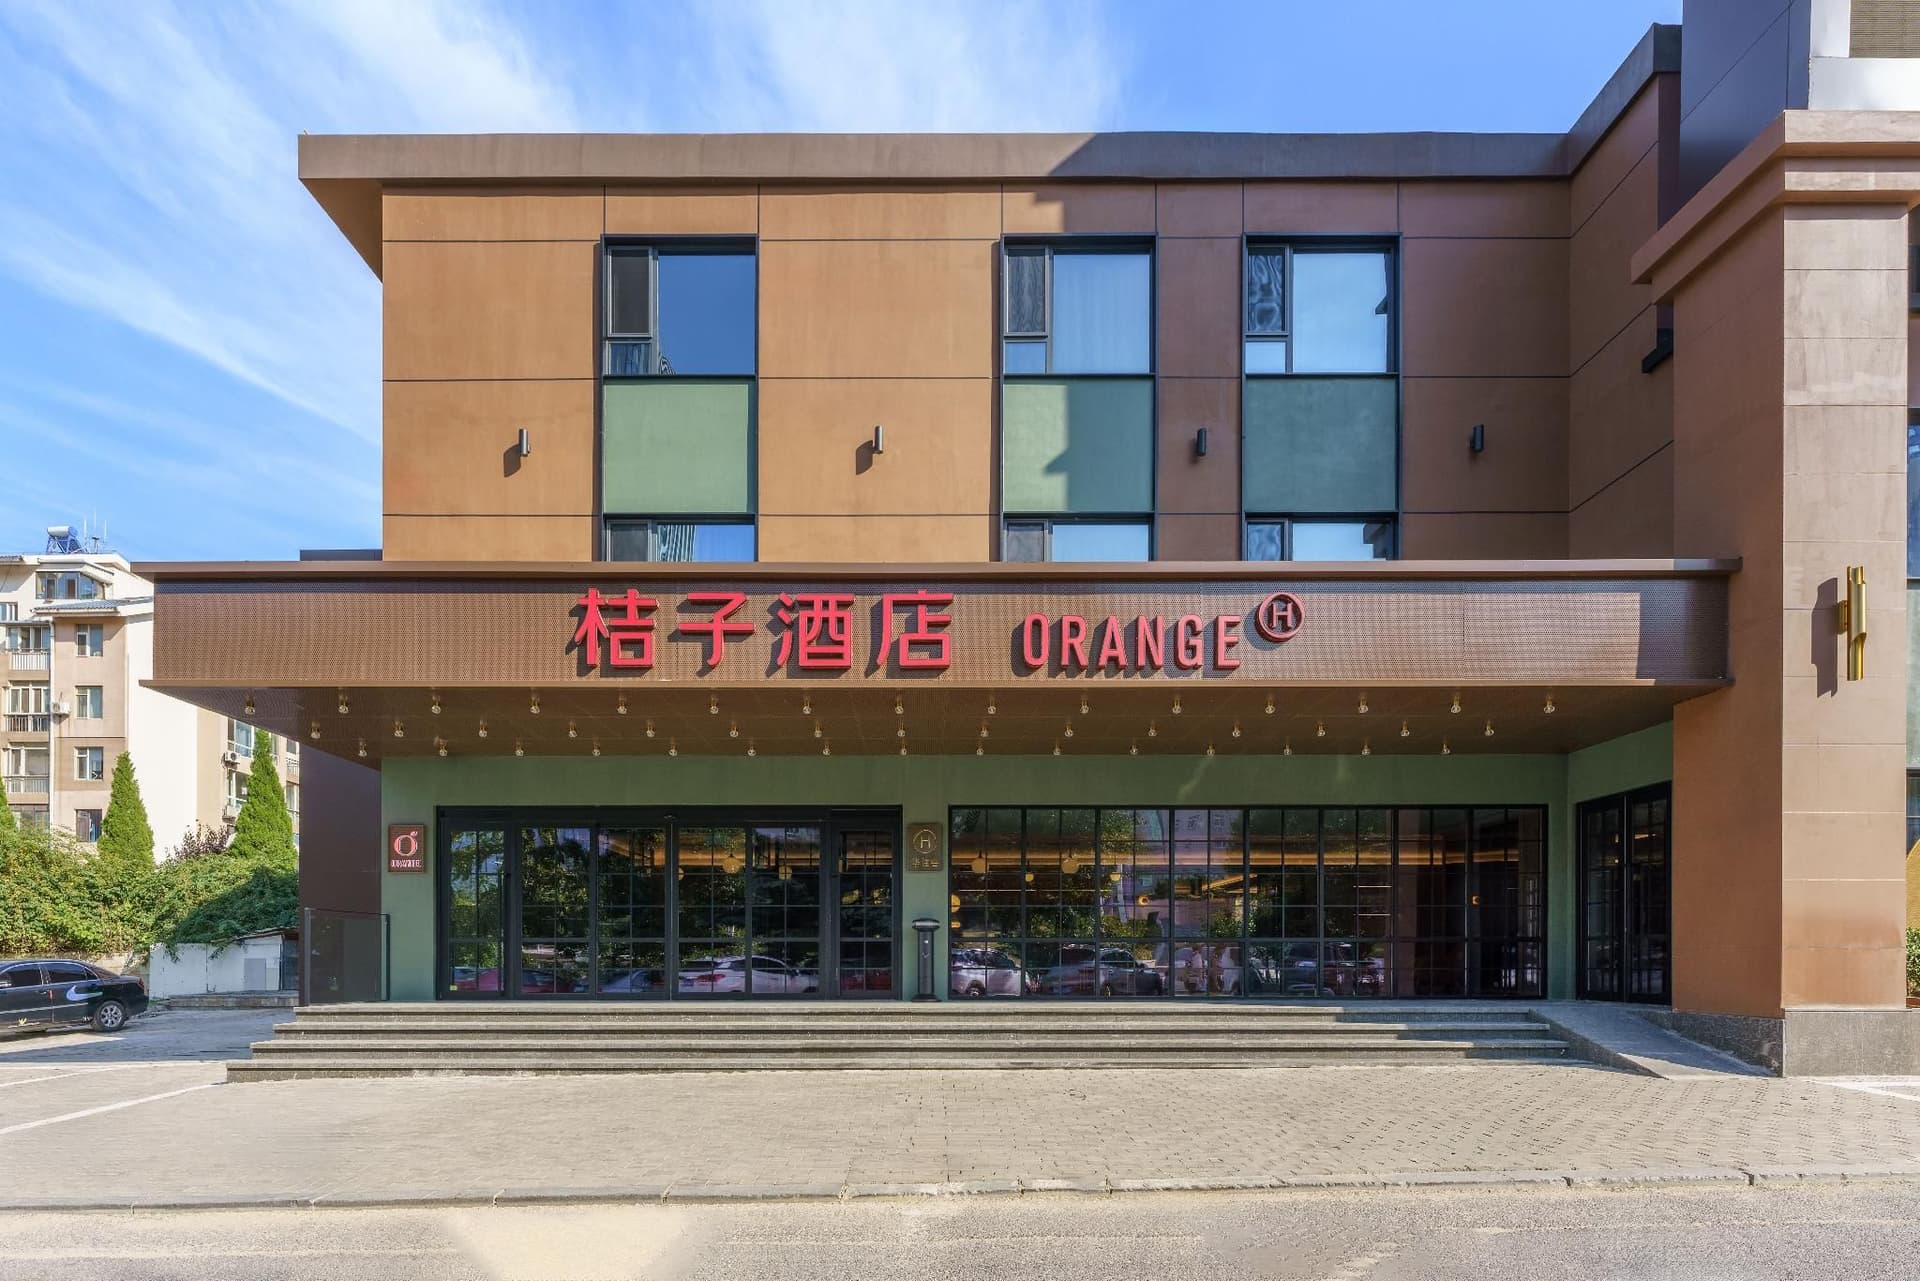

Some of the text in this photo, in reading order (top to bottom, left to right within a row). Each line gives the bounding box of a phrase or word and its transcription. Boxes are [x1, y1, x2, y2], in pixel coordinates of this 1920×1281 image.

[575, 588, 954, 668] 桔子酒店
[1023, 612, 1241, 670] ORANGE
